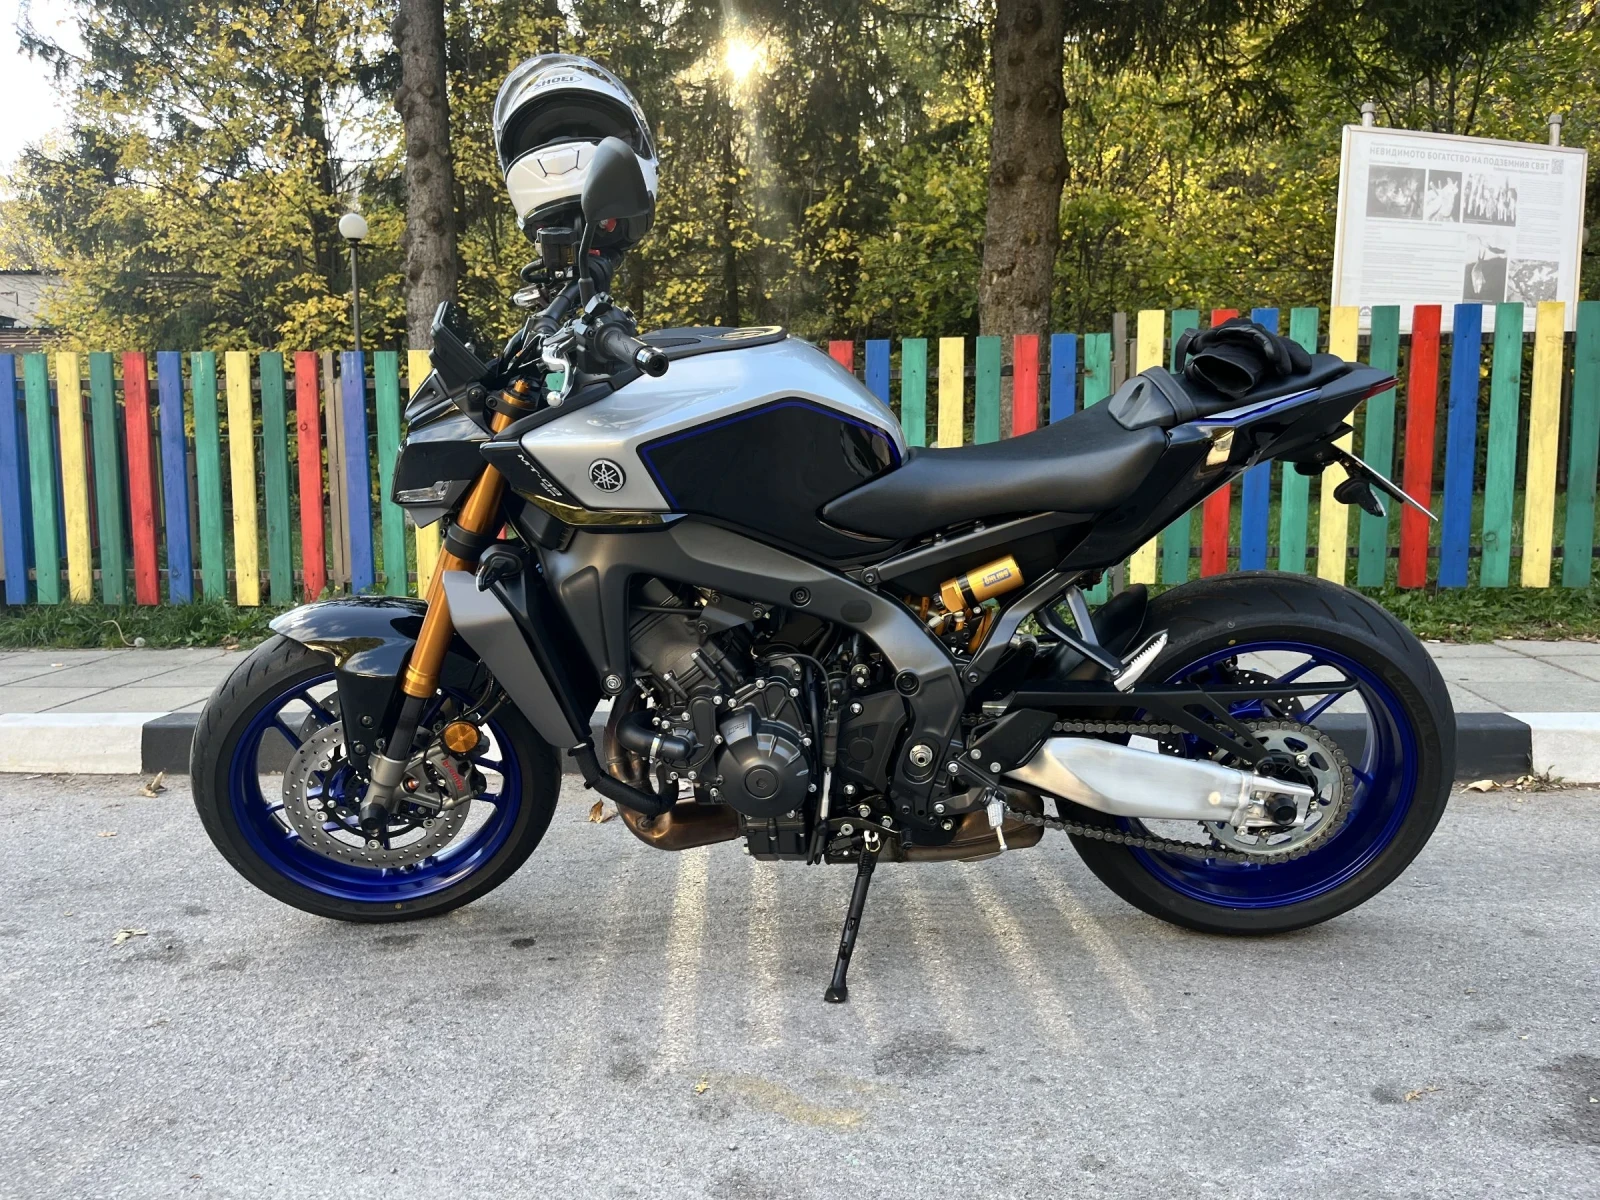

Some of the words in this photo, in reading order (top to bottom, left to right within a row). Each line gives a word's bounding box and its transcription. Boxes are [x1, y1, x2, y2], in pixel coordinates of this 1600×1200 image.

[534, 76, 574, 89] SHOEI
[1369, 146, 1426, 160] НЕВИДИМОТО
[1427, 151, 1470, 163] БОГАТСТВО
[1471, 155, 1482, 164] НА
[1483, 157, 1530, 169] ПОДЗЕМНИЯ
[1530, 162, 1549, 171] СВЯТ
[517, 454, 562, 496] MT-09
